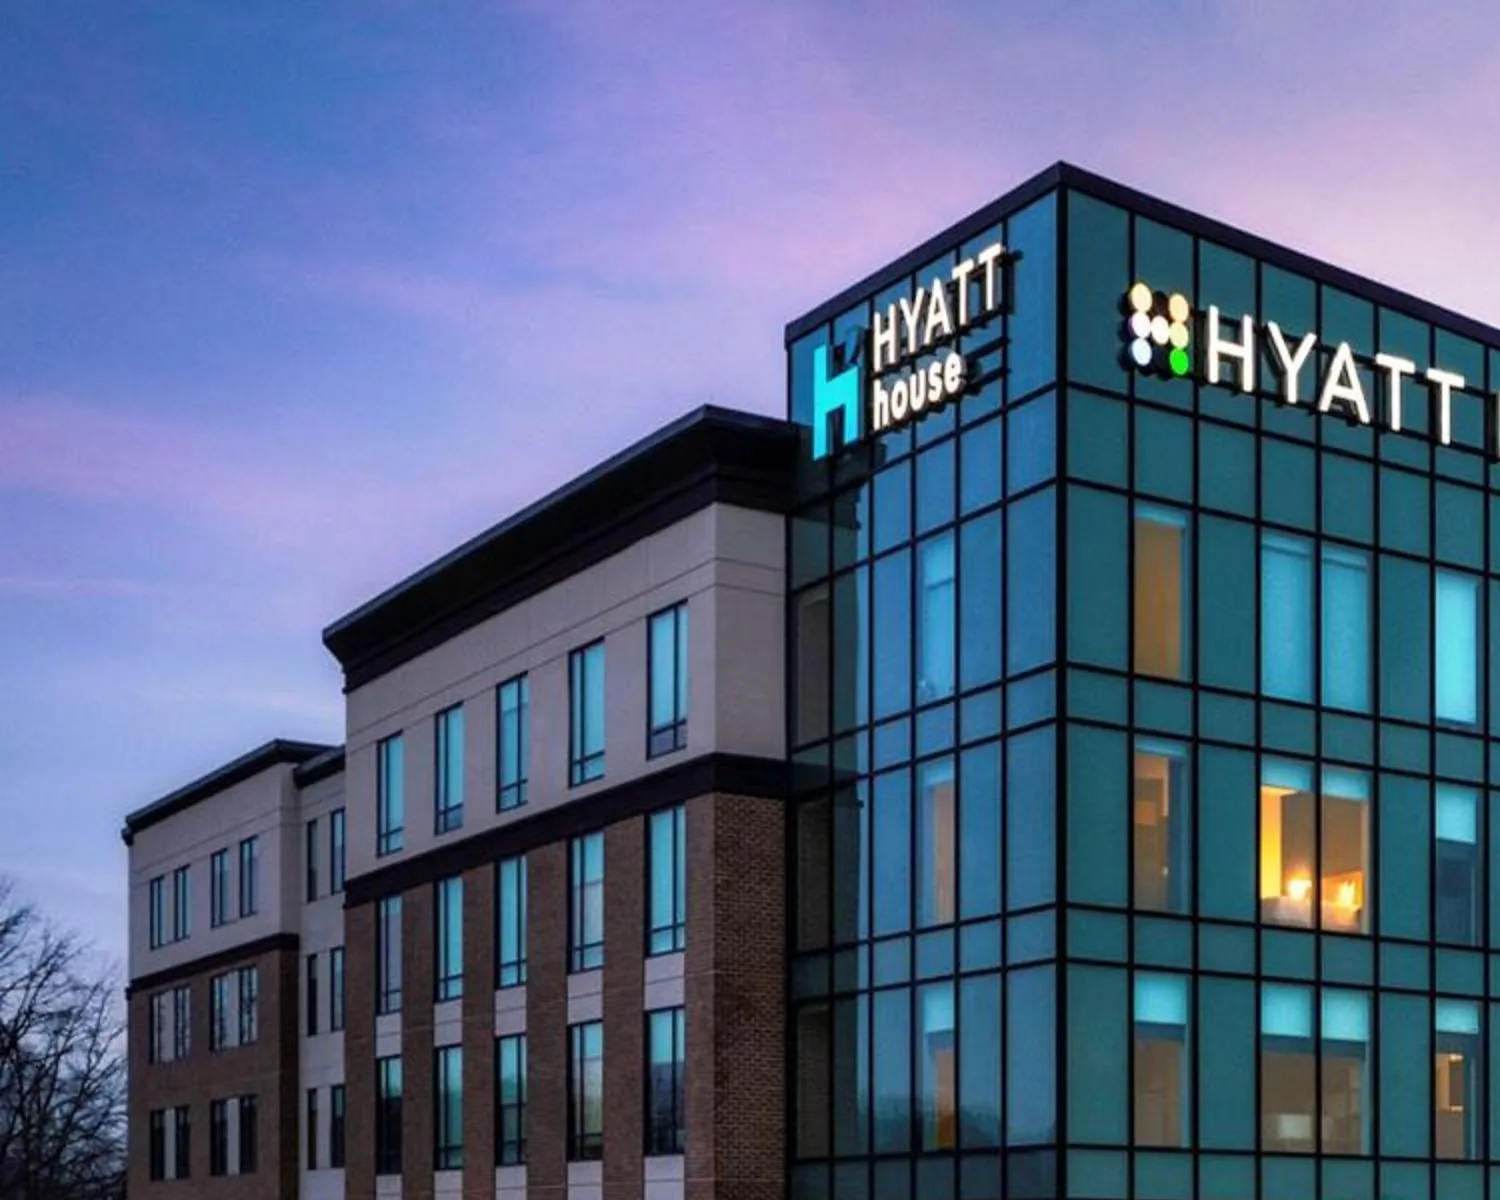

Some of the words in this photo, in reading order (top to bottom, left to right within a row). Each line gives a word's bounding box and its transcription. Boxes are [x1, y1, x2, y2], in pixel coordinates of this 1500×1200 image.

[872, 243, 1005, 373] HYATT
[872, 351, 964, 431] house
[1205, 304, 1465, 446] HYATT
